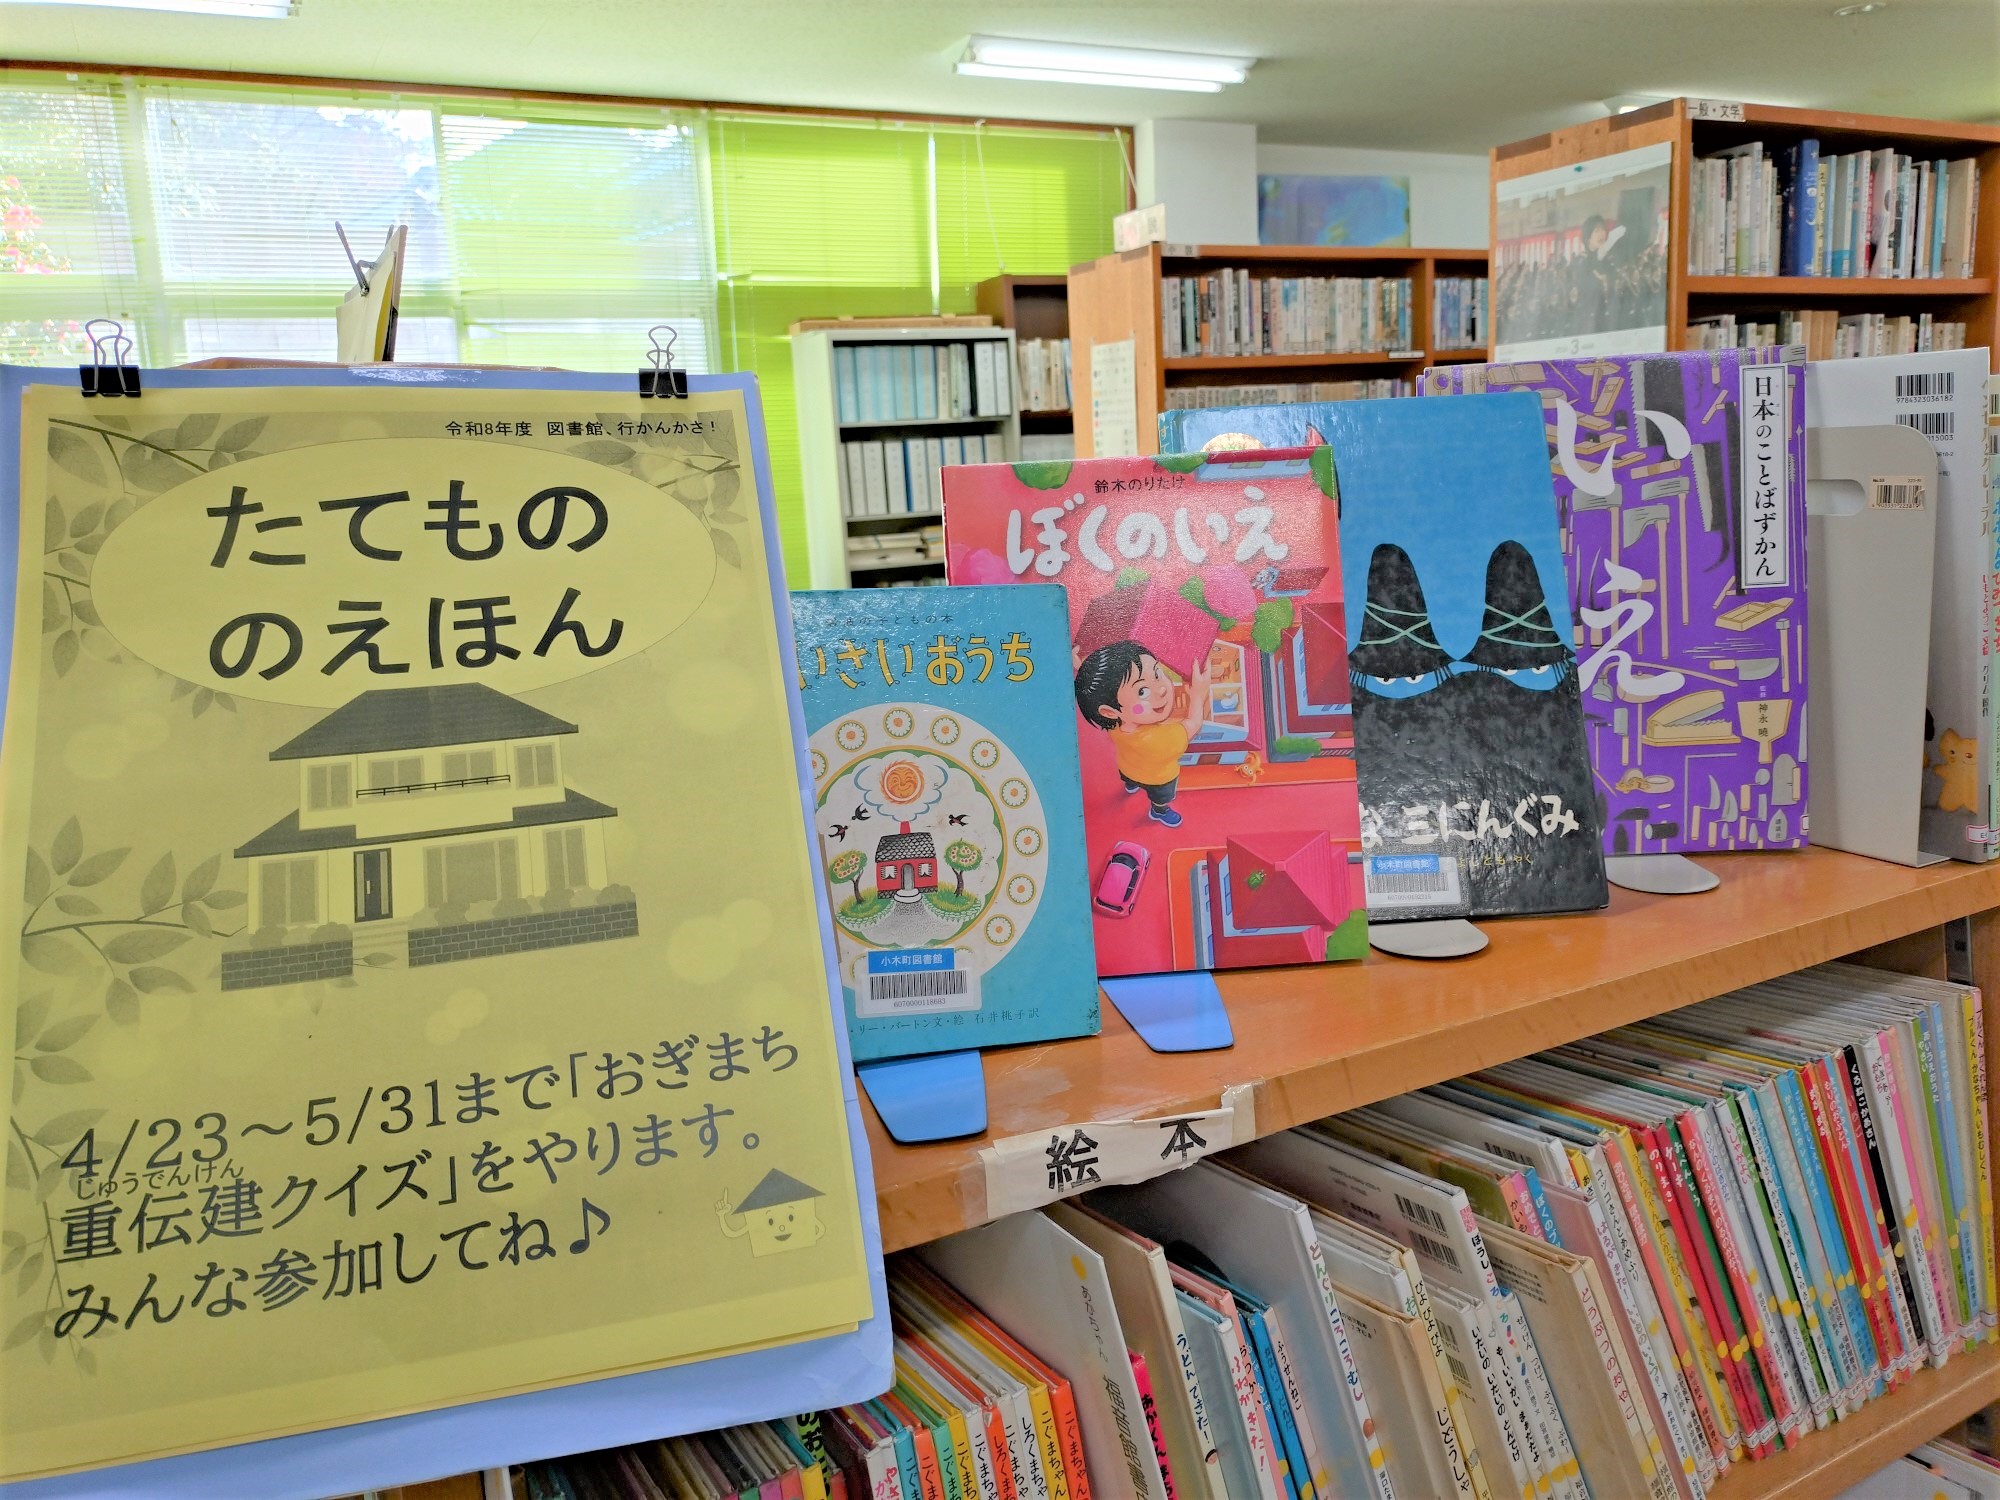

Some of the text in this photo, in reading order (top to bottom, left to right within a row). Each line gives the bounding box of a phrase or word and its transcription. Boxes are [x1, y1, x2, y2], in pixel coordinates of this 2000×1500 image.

[445, 419, 717, 437] 令和8年度 図書館、行かんかさ！
[1896, 394, 1954, 404] 9784323036182
[1094, 475, 1186, 493] 鈴木のりたけ
[1752, 375, 1778, 577] 日本のことばずかん
[207, 480, 609, 568] たてもの
[1007, 486, 1289, 577] ぼくのいえ
[209, 587, 624, 681] のえほん
[1401, 793, 1580, 844] 三にんぐみ
[881, 953, 943, 967] 小木町図書館
[893, 997, 946, 1008] 6070000118683
[1917, 1040, 1927, 1072] やさい
[1922, 1032, 1940, 1103] あいうえおうた
[1850, 1064, 1876, 1149] くろねこかあさん
[56, 1103, 760, 1264] 重伝建クイズ」をやります。
[77, 1157, 245, 1200] じゅうでんけん
[1649, 1149, 1672, 1201] のりまき
[1665, 1146, 1683, 1187] ケーキ
[1674, 1141, 1700, 1206] おべんとう
[1726, 1124, 1749, 1183] いしゃがよい
[1277, 1341, 1302, 1411] ふうせんねこ
[1471, 1326, 1491, 1370] いたいの
[1487, 1374, 1505, 1416] いたいの
[1581, 1288, 1637, 1421] どうぶつのおやこ
[1436, 1407, 1471, 1492] じどうしゃ
